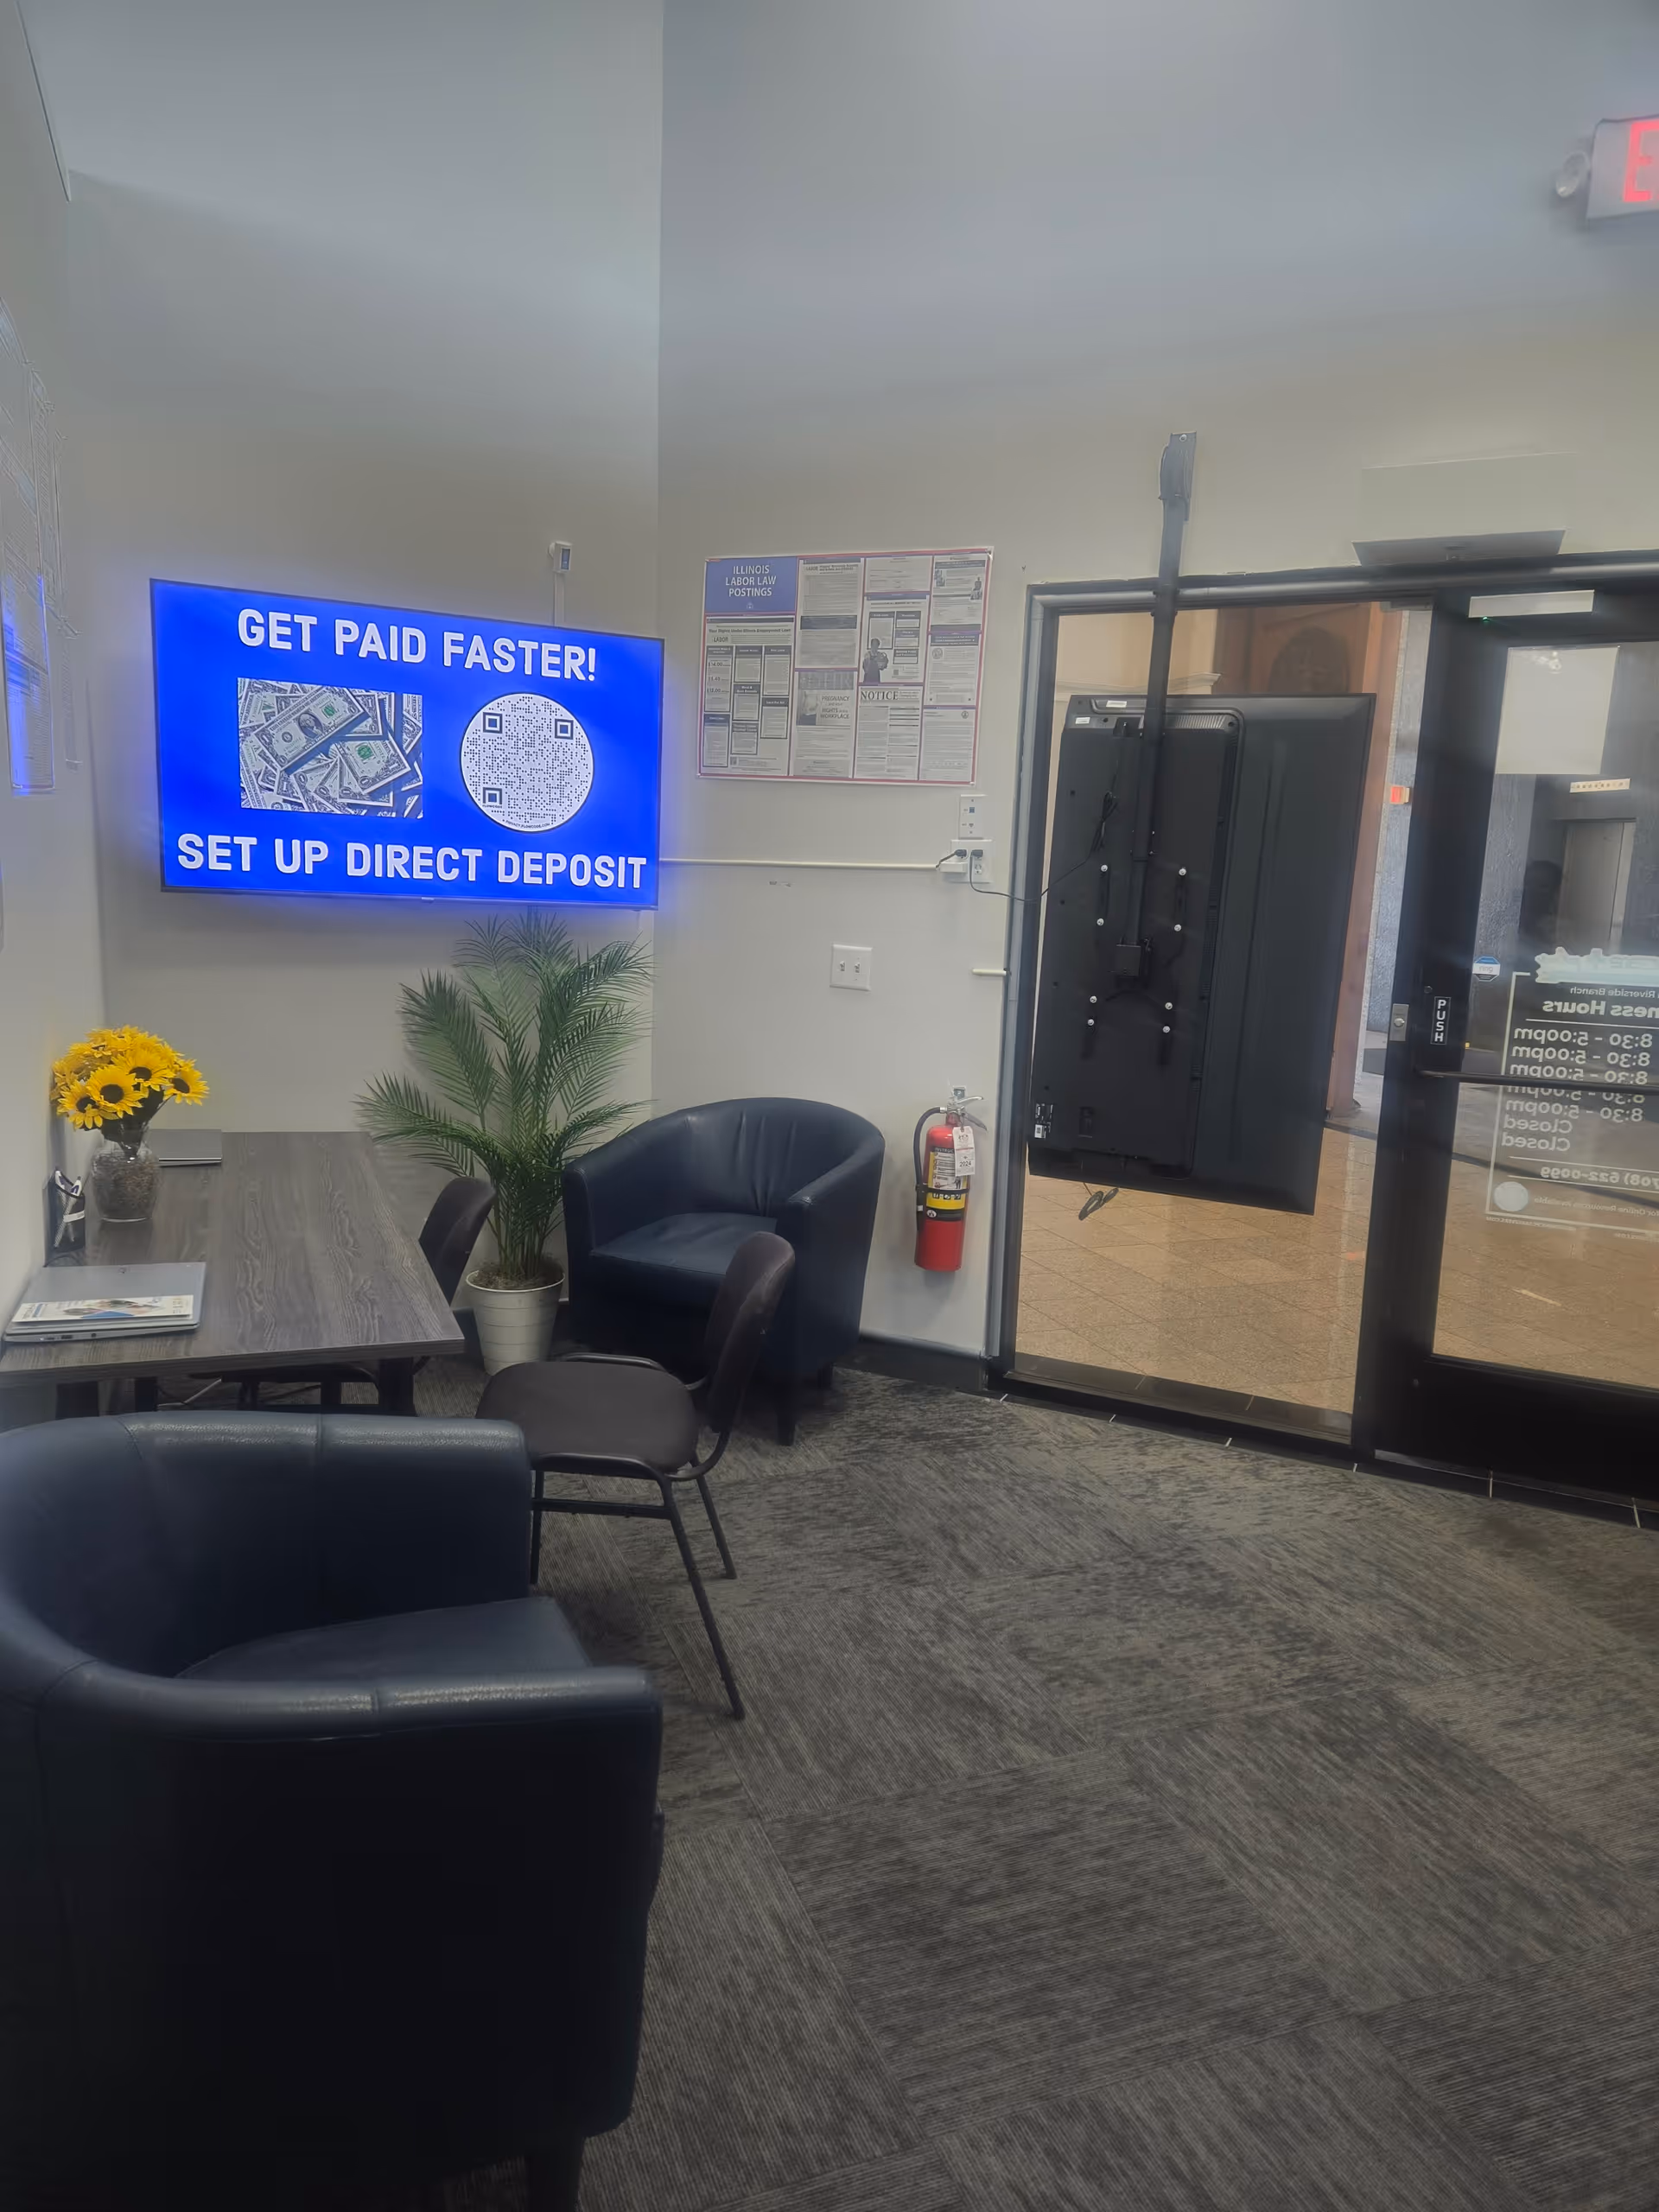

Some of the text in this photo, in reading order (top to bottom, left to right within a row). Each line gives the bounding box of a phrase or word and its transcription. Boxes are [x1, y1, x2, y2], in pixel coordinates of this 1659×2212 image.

[734, 564, 770, 575] ILLINOIS
[725, 575, 777, 586] LABOR LAW
[728, 587, 772, 597] POSTINGS
[238, 608, 597, 682] GET PAID FASTER!
[860, 690, 899, 701] NOTICE
[177, 834, 647, 889] SET UP DIRECT DEPOSIT
[1433, 1000, 1447, 1042] PUSH
